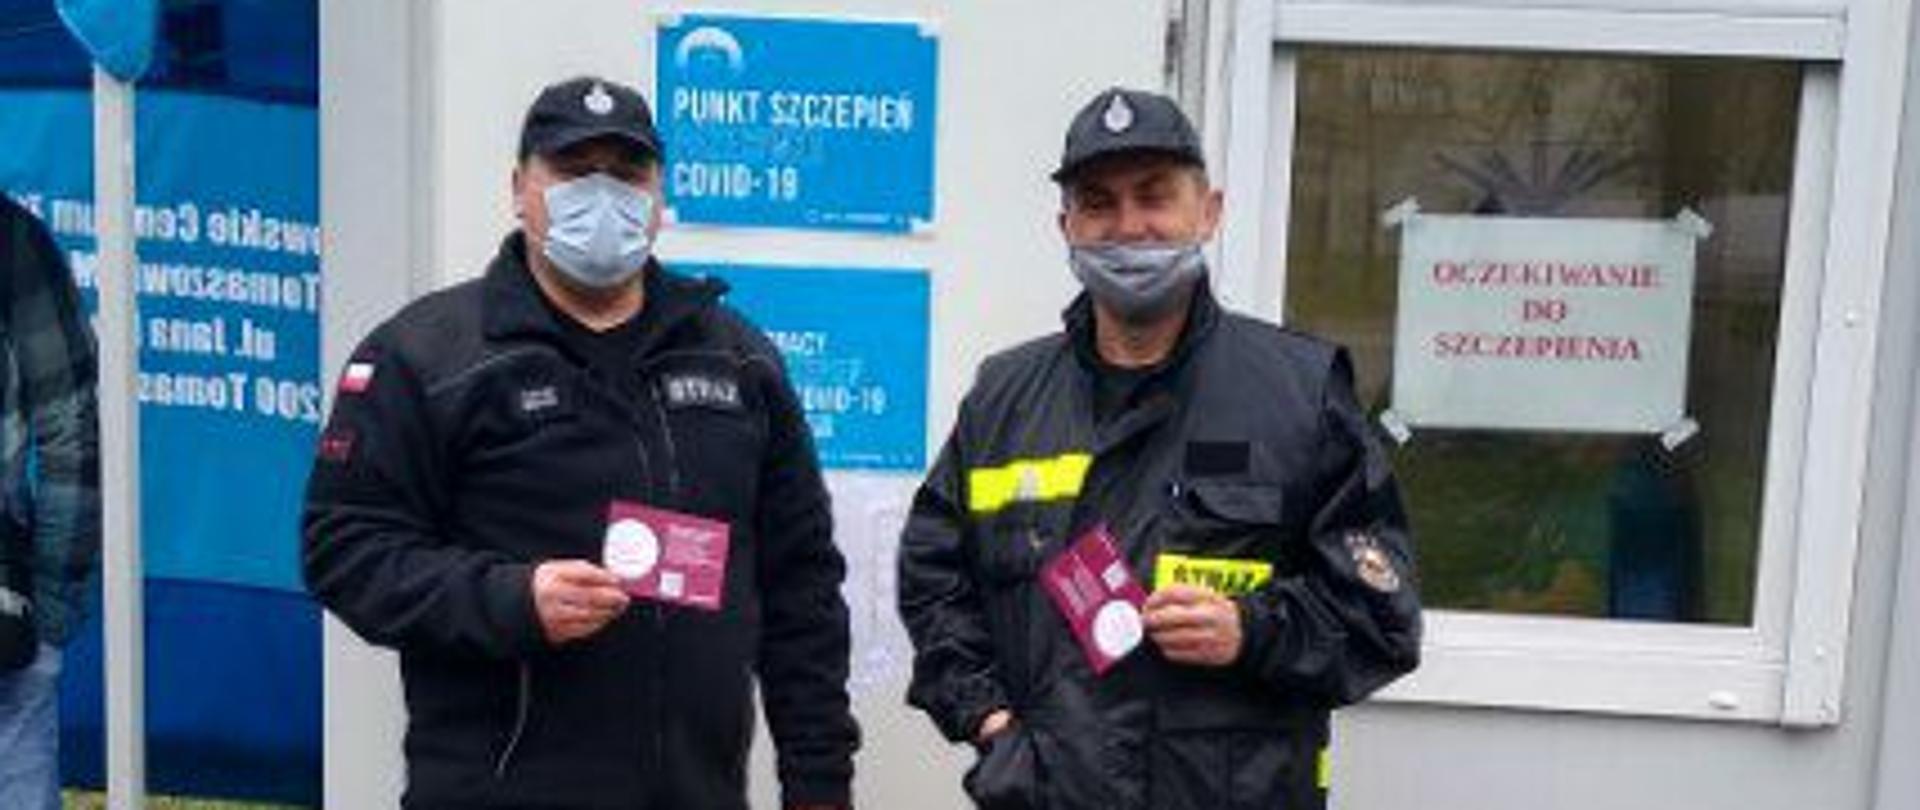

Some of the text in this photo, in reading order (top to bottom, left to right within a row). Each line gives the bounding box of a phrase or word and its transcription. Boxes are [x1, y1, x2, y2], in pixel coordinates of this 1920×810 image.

[673, 86, 915, 132] PUNKT SZCZEPIEŃ
[673, 162, 798, 201] COVID-19
[1433, 263, 1661, 288] OCZEKIWANIE
[1522, 299, 1568, 323] DO
[1433, 332, 1642, 361] SZCZEPIENIA
[797, 386, 887, 415] OVID-19
